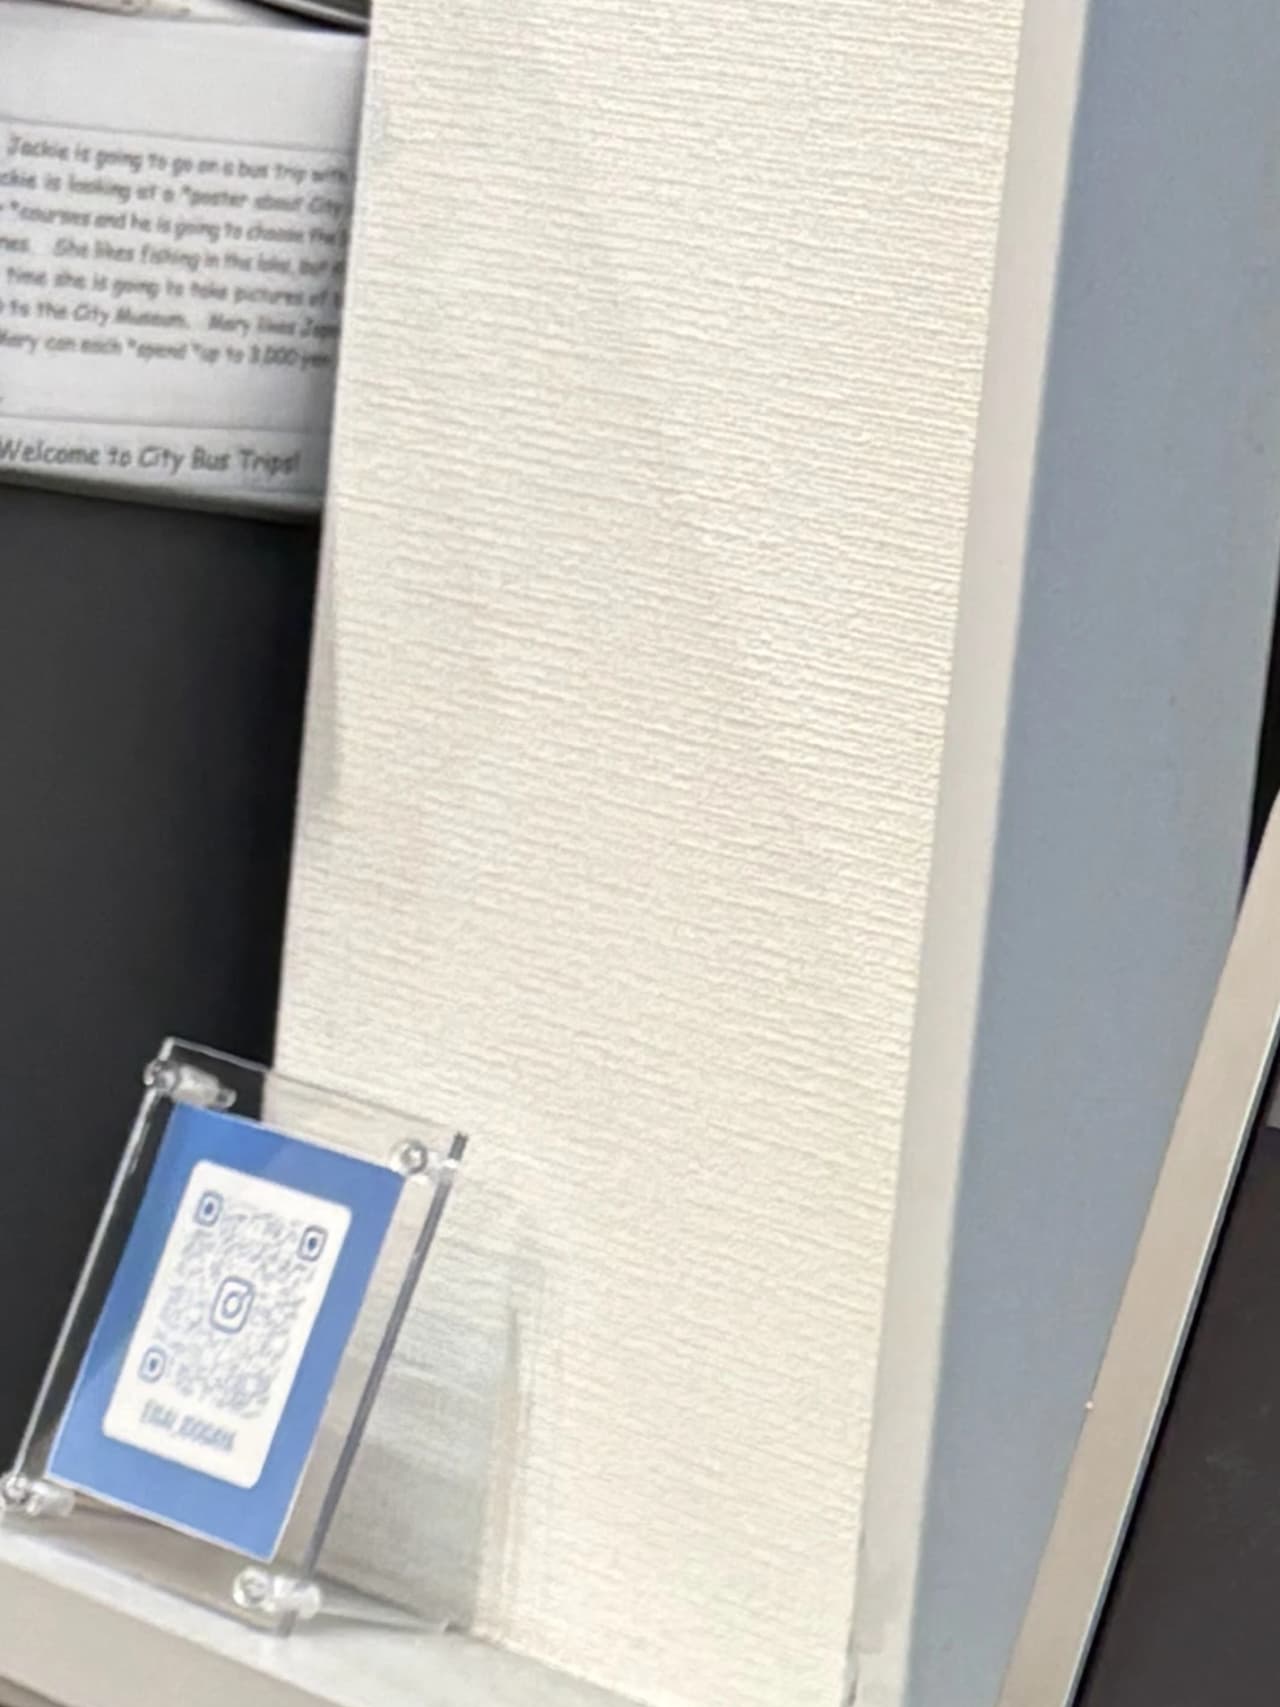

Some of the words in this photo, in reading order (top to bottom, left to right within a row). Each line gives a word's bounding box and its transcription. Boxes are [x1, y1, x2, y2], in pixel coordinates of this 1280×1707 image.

[74, 143, 89, 163] is
[95, 149, 141, 173] going
[148, 152, 167, 170] to
[172, 158, 192, 177] go
[238, 160, 267, 178] bus
[44, 176, 61, 191] is
[68, 173, 130, 204] looking
[95, 212, 126, 229] and
[131, 213, 151, 232] he
[157, 217, 171, 233] is
[174, 222, 219, 243] going
[224, 223, 242, 240] to
[53, 237, 88, 258] She
[141, 243, 198, 272] fishing
[224, 252, 251, 271] the
[55, 272, 86, 290] she
[93, 273, 108, 292] is
[112, 279, 158, 299] going
[166, 280, 184, 297] to
[11, 300, 29, 318] to
[37, 301, 68, 320] the
[73, 303, 109, 327] City
[225, 348, 244, 364] to
[0, 438, 98, 466] Welcome
[108, 446, 131, 466] to
[138, 445, 185, 475] City
[191, 446, 230, 471] Bus
